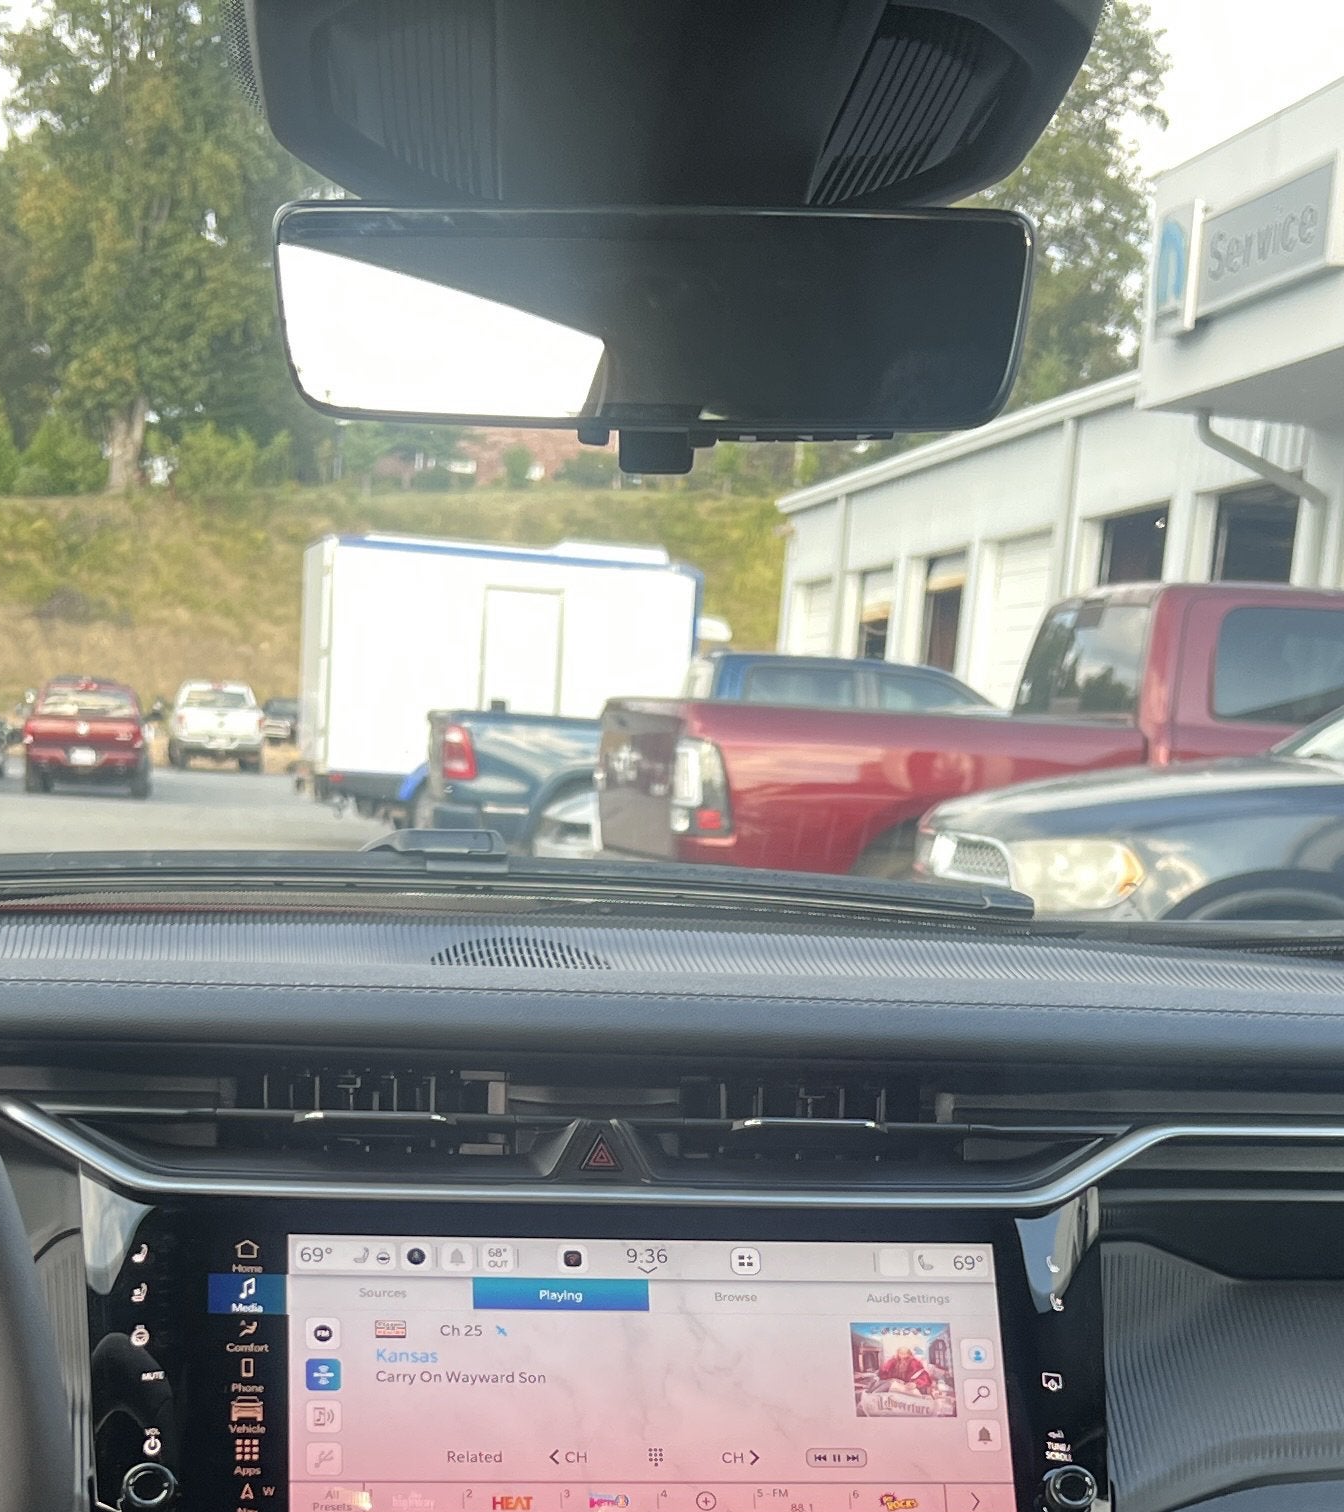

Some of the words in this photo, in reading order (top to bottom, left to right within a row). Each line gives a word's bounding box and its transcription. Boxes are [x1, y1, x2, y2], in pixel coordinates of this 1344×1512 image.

[1207, 203, 1319, 282] Service
[626, 1248, 668, 1264] 9:36
[231, 1264, 263, 1273] Home
[488, 1259, 508, 1268] OUT
[359, 1287, 407, 1298] Sources
[539, 1289, 583, 1302] Playing
[714, 1291, 757, 1302] Browse
[866, 1293, 900, 1304] Audio
[902, 1293, 951, 1306] Settings
[231, 1303, 263, 1313] Media
[440, 1324, 461, 1337] Ch
[464, 1325, 483, 1337] 25
[226, 1342, 269, 1353] Comfort
[376, 1349, 439, 1364] Kansas
[141, 1370, 165, 1381] MUTE
[376, 1370, 416, 1385] Carry
[420, 1370, 442, 1383] On
[445, 1371, 516, 1385] Wayward
[519, 1372, 546, 1384] Son
[231, 1382, 264, 1393] Phone
[228, 1424, 266, 1434] Vehicle
[447, 1450, 503, 1463] Related
[564, 1451, 588, 1463] CH
[721, 1452, 745, 1464] CH
[233, 1465, 261, 1476] Apps
[262, 1486, 276, 1496] W
[325, 1489, 339, 1500] All
[466, 1489, 473, 1498] 2
[564, 1489, 570, 1498] 3
[660, 1490, 668, 1498] 4
[772, 1489, 789, 1498] FM
[852, 1490, 859, 1498] 6
[312, 1502, 353, 1512] Presets
[492, 1496, 533, 1511] HEAT
